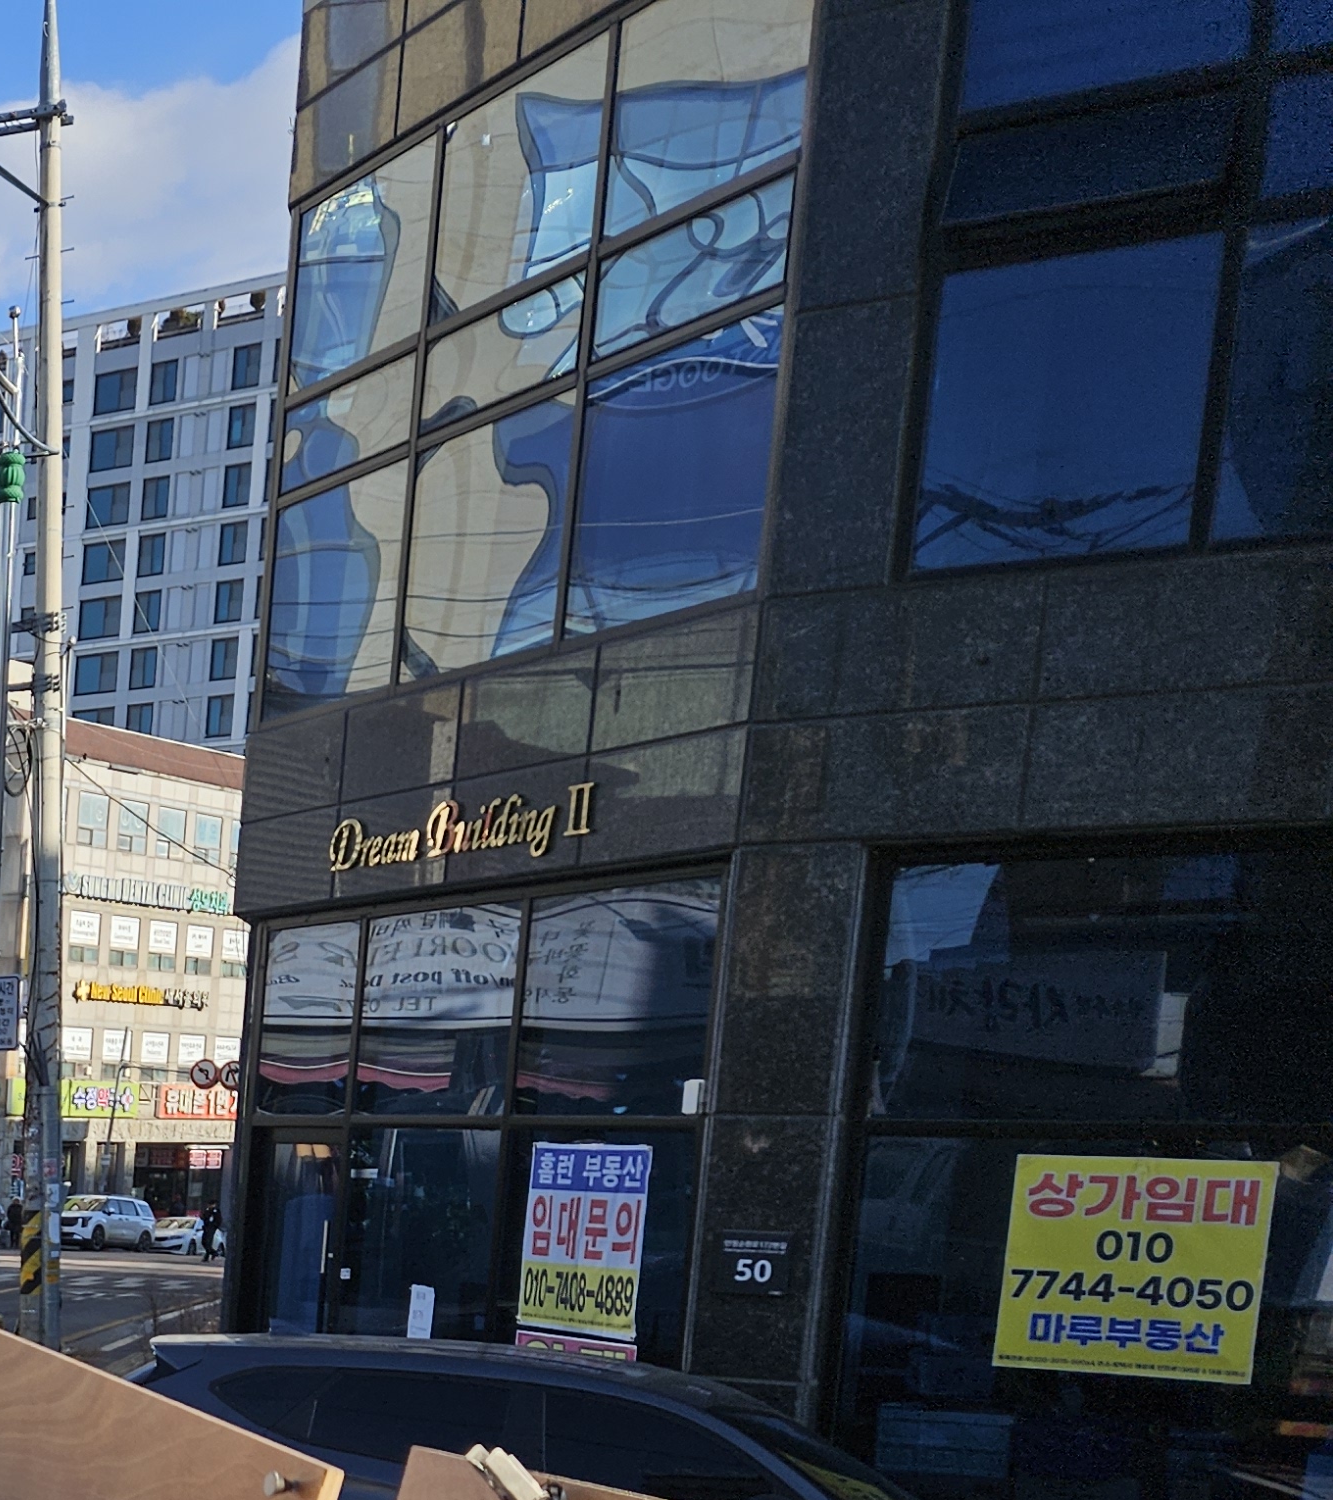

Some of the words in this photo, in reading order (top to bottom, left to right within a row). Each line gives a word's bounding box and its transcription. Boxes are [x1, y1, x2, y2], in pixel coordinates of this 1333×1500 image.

[330, 818, 420, 872] Dream
[426, 793, 556, 858] Building
[111, 983, 138, 1003] Seoul
[537, 1152, 576, 1185] 홈런
[582, 1154, 644, 1188] 부동산
[1028, 1172, 1261, 1226] 상가임대
[532, 1195, 642, 1265] 임대문의
[1096, 1230, 1174, 1263] 010
[523, 1267, 635, 1317] 010-7408-4889
[734, 1258, 773, 1283] 50
[1010, 1269, 1255, 1312] 7744-4050
[1028, 1312, 1225, 1355] 마루부동산
